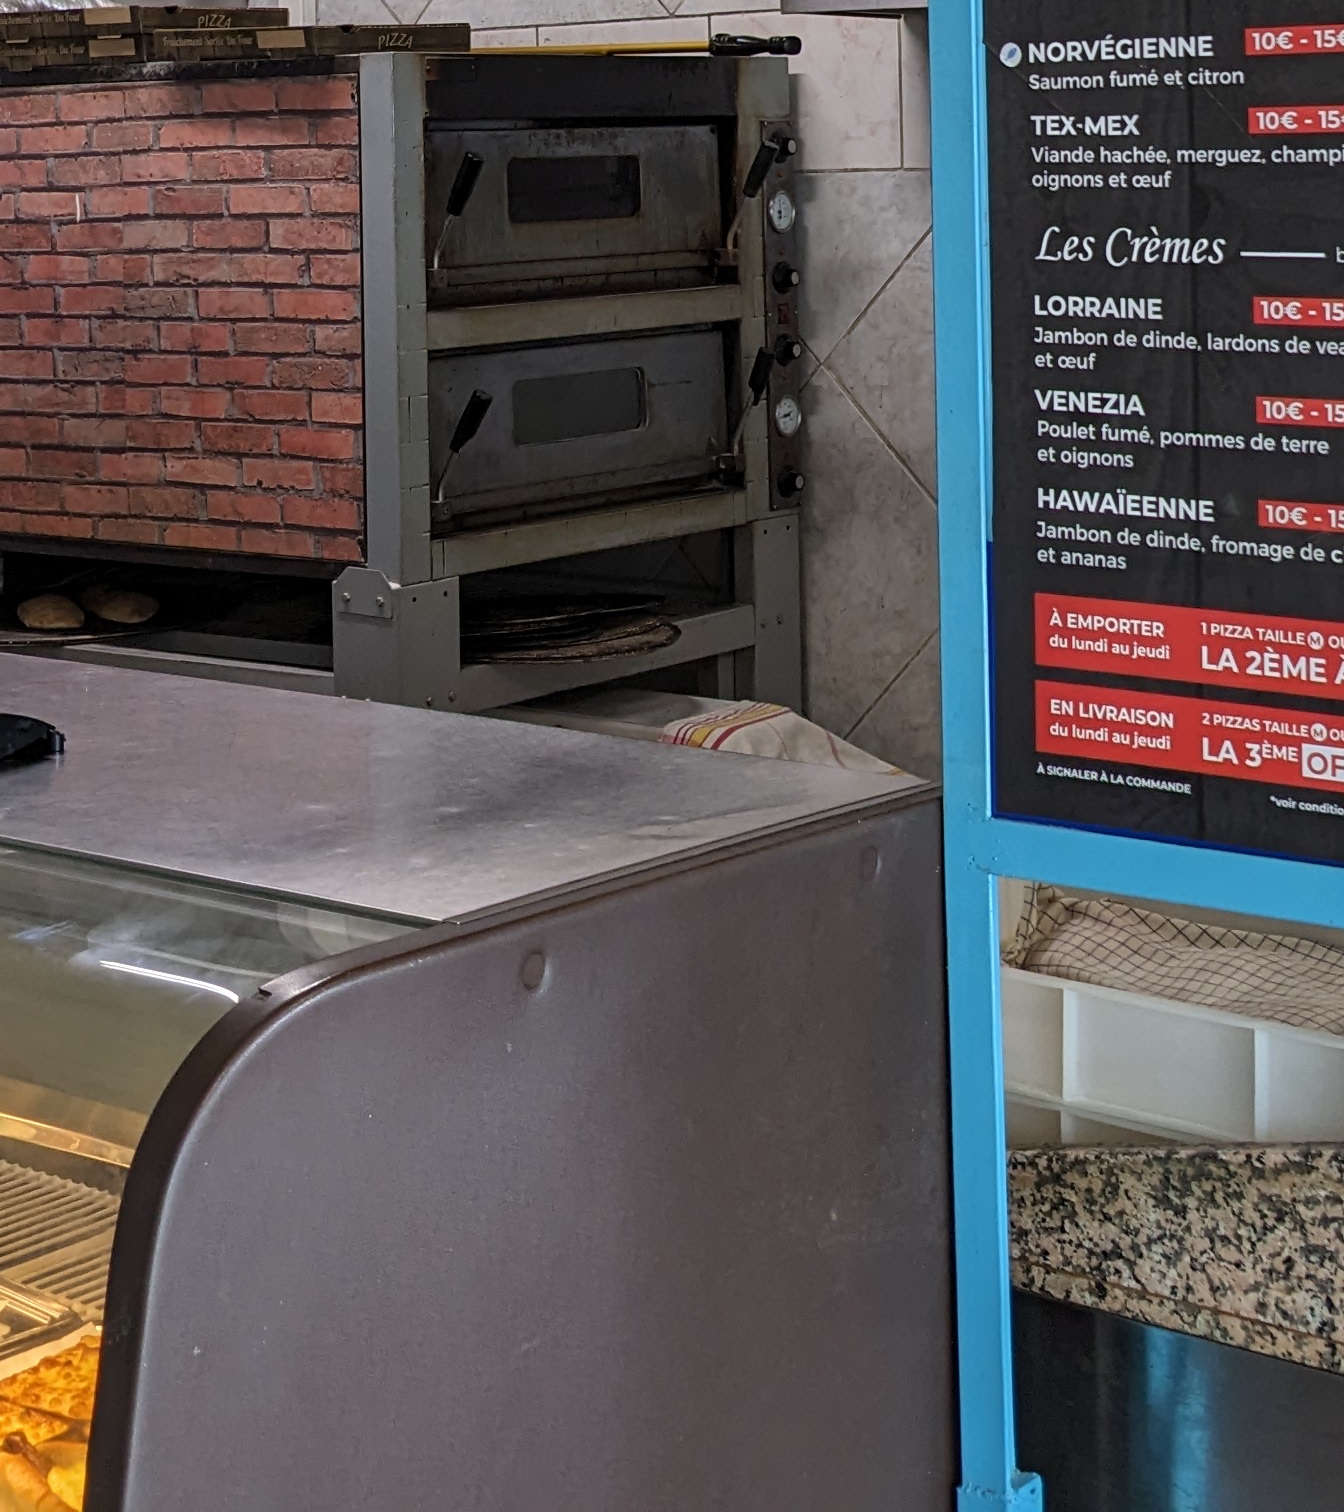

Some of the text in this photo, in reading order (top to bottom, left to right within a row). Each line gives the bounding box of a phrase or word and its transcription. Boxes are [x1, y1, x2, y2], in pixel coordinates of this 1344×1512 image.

[197, 15, 232, 29] PIZZA
[377, 33, 414, 50] PIZZA
[1028, 34, 1214, 64] NORVÉGIENNE
[1251, 31, 1294, 51] 10€
[1029, 114, 1140, 137] TEX-MEX
[1034, 225, 1227, 267] Les Crèmes
[1034, 294, 1164, 320] LORRAINE
[1034, 388, 1146, 417] VENEZIA
[1036, 446, 1134, 469] et oignons
[1037, 487, 1215, 523] HAWAÏEENNE
[1049, 607, 1165, 638] À EMPORTER
[1200, 621, 1208, 635] 1
[1210, 622, 1254, 640] PIZZA
[1255, 627, 1306, 646] TAILLE
[1048, 633, 1170, 660] du lundi au jeudi
[1201, 645, 1240, 673] LA
[1244, 645, 1328, 683] 2ÈME
[1050, 698, 1174, 729] EN LIVRAISON
[1201, 712, 1211, 725] 2
[1212, 713, 1262, 732] PIZZAS
[1262, 719, 1309, 738] TAILLE
[1202, 736, 1240, 766] LA
[1244, 739, 1299, 768] 3ÈME
[1036, 761, 1192, 795] À SIGNALER À LA COMMANDE
